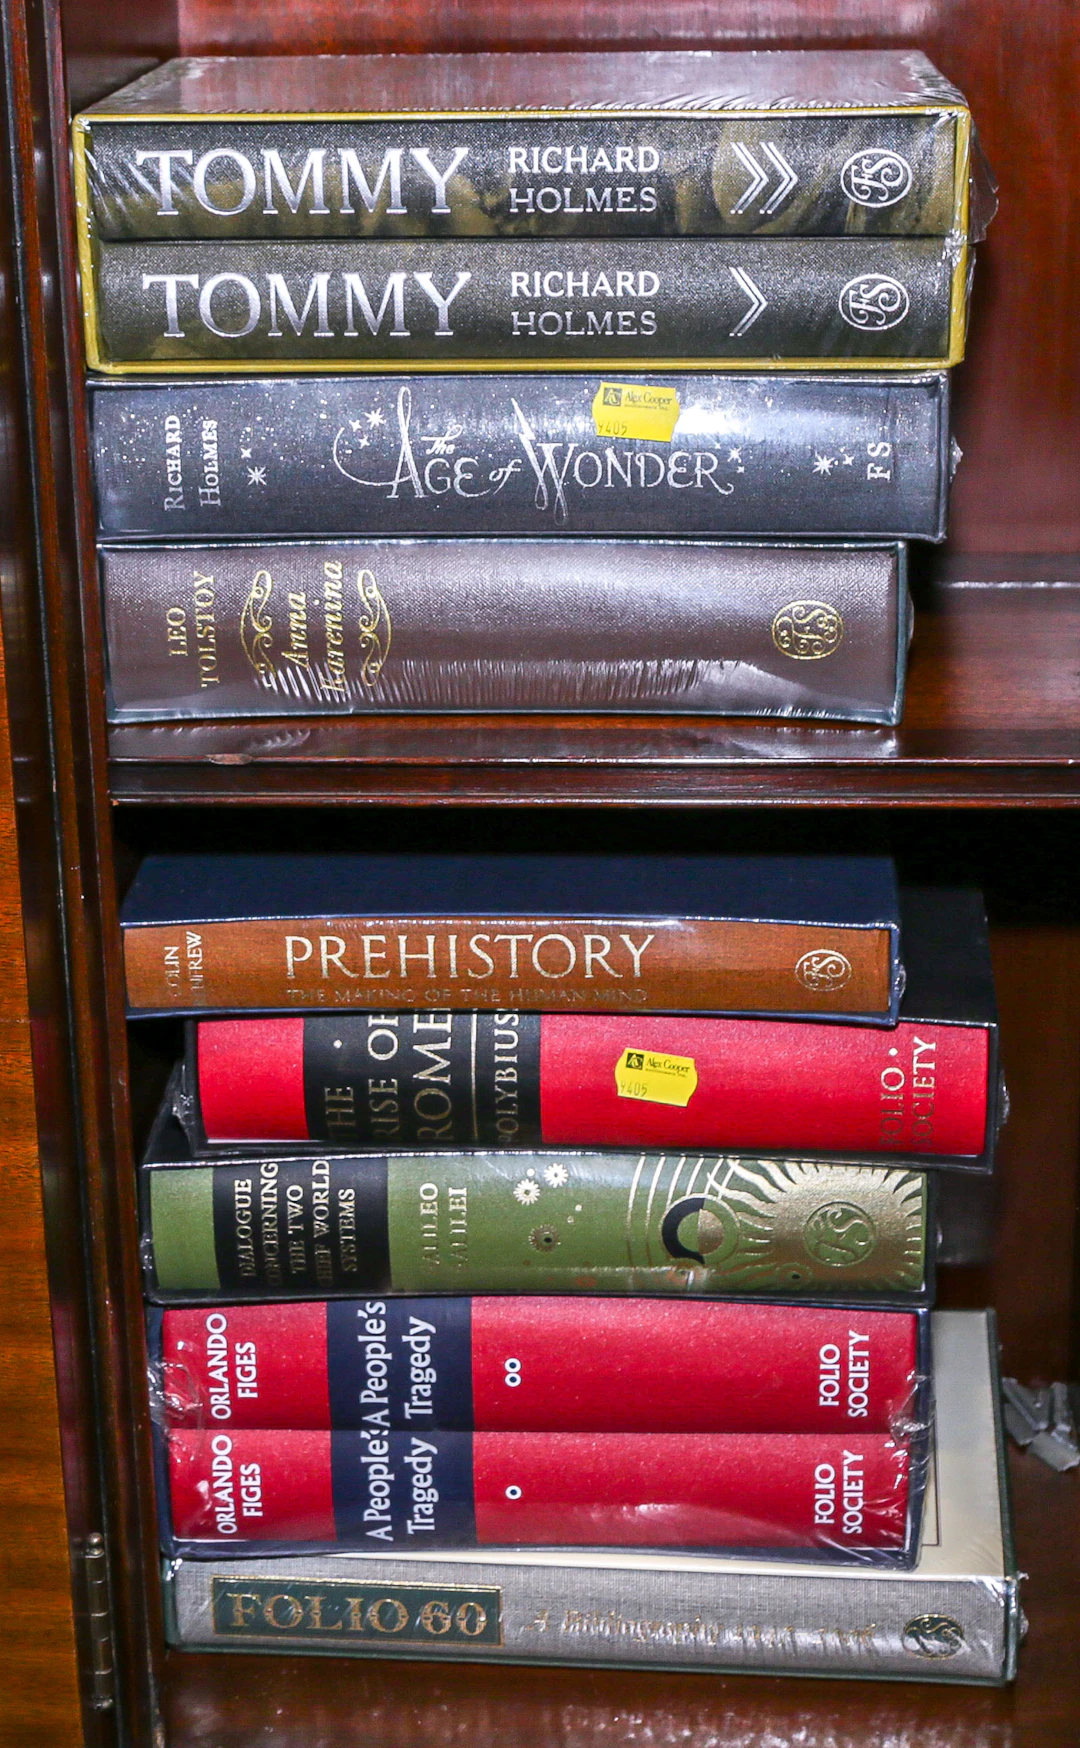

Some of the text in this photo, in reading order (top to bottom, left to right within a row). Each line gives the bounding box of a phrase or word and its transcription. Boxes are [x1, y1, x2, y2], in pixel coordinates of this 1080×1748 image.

[136, 147, 469, 216] TOMMY
[508, 146, 660, 174] RICHARD
[509, 187, 657, 213] HOLMES
[142, 272, 471, 338] TOMMY
[511, 271, 660, 297] RICHARD
[512, 311, 658, 336] HOLMES
[625, 391, 673, 406] Alex Cooper
[164, 415, 186, 511] RICHARD
[199, 420, 221, 506] HOLMES
[421, 425, 462, 455] The
[488, 459, 522, 494] of
[511, 397, 734, 525] WONDER
[166, 607, 188, 657] LEO
[194, 571, 220, 688] TOLSTOY
[282, 592, 309, 669] Anna
[314, 561, 346, 692] Karenina
[164, 946, 182, 997] OLIN
[186, 931, 204, 1000] NFREW
[285, 934, 654, 979] PREHISTORY
[286, 988, 649, 1003] THE MAKING OF THE HUMAN MIND
[413, 1010, 453, 1140] ROME
[494, 1009, 520, 1143] POLYBIUS
[646, 1057, 662, 1069] Alex
[664, 1059, 691, 1074] Cooper
[911, 1036, 936, 1145] SOCIETY
[368, 1078, 400, 1139] RISE
[880, 1067, 905, 1145] FOLIO
[234, 1178, 257, 1278] DIALOGUE
[286, 1184, 305, 1274] THE TWO
[312, 1159, 330, 1238] WORLD
[338, 1187, 358, 1272] SYSTEMS
[419, 1182, 440, 1271] ALILEO
[448, 1187, 469, 1270] ALILEI
[206, 1312, 232, 1420] ORLANDO
[235, 1341, 259, 1399] FIGES
[357, 1301, 393, 1428] A People's
[401, 1315, 437, 1420] Tragedy
[819, 1343, 841, 1407] FOLIO
[847, 1330, 870, 1418] SOCIETY
[211, 1434, 238, 1535] ORLANDO
[239, 1462, 264, 1518] FIGES
[403, 1436, 440, 1535] Tragedy
[814, 1463, 836, 1525] FOLIO
[842, 1450, 864, 1534] SOCIETY
[365, 1525, 394, 1541] A
[226, 1592, 488, 1636] FOLIO 60
